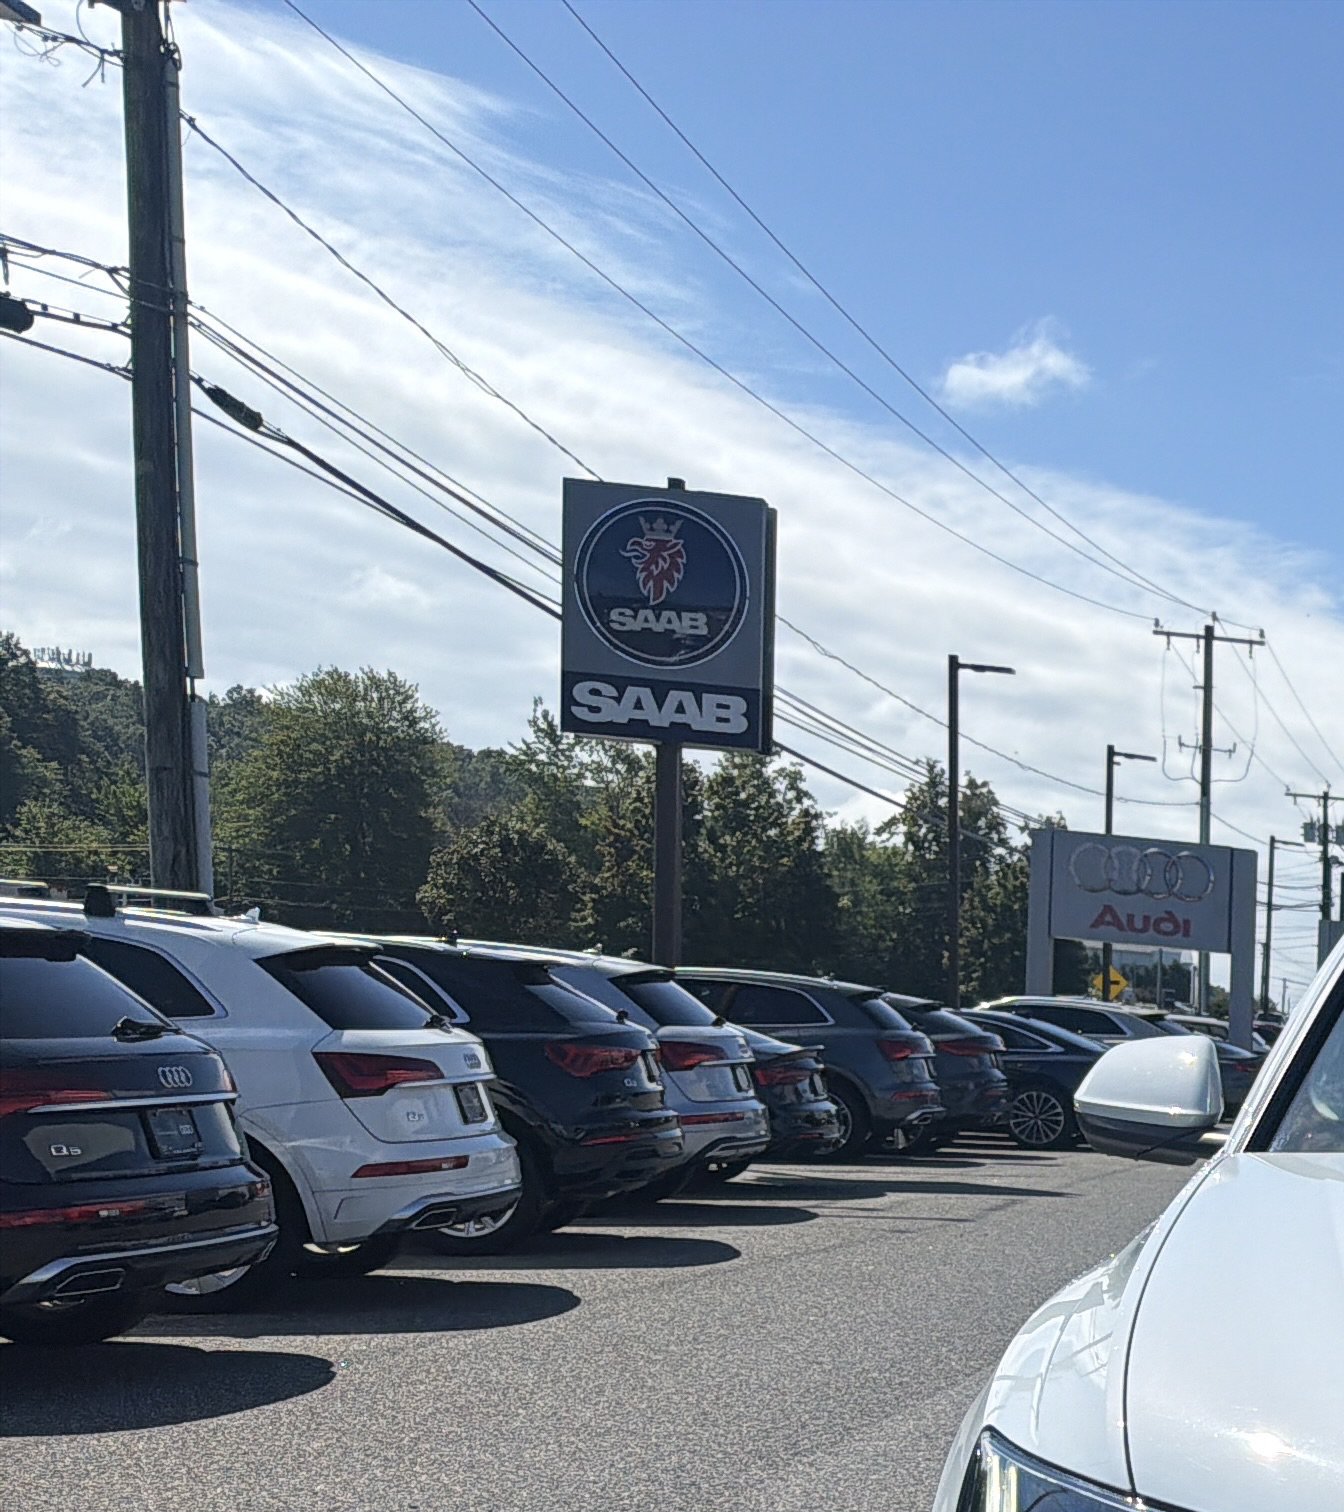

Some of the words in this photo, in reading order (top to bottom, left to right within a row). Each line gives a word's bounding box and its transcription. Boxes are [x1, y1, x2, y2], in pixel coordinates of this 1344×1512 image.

[608, 607, 709, 636] SAAB
[570, 680, 749, 734] SAAB
[1089, 904, 1191, 938] Audi
[50, 1144, 82, 1156] Q5
